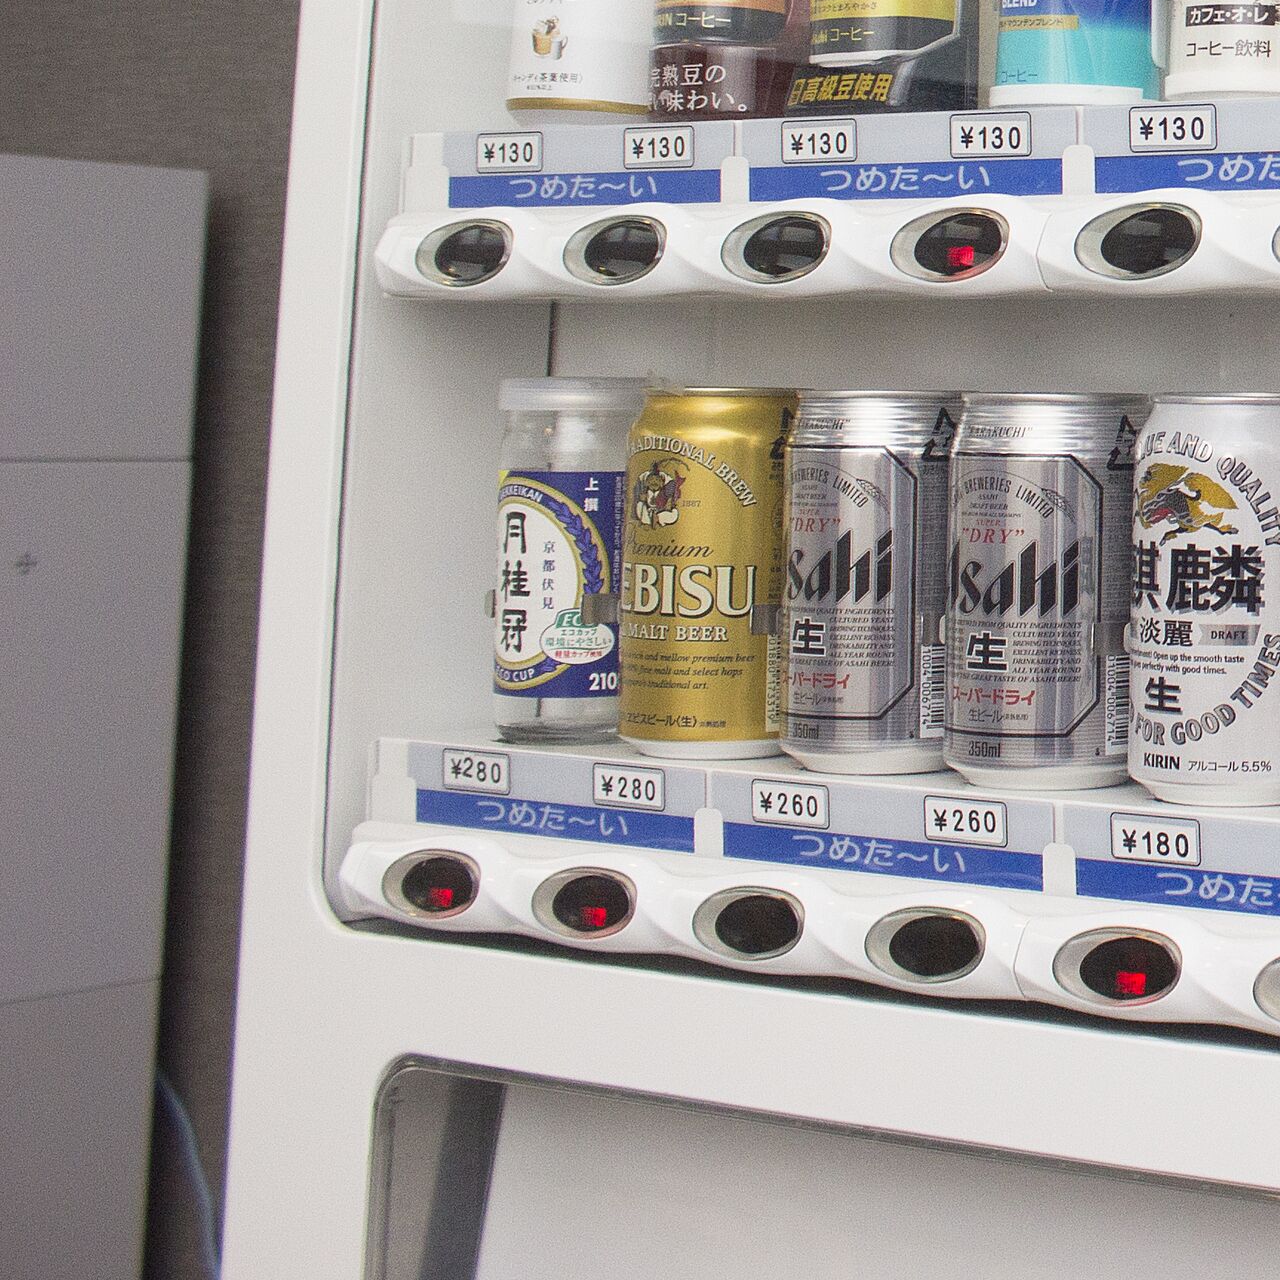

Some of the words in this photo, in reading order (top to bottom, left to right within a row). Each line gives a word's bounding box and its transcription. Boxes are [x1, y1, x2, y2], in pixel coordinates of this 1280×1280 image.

[676, 13, 731, 29] コーヒー
[1189, 7, 1269, 26] カフェ・オ・レ
[830, 26, 875, 42] コーヒー
[1186, 40, 1272, 59] コーヒー飲料
[959, 126, 1022, 150] ¥130
[1139, 115, 1206, 141] ¥130
[484, 144, 535, 163] ¥130
[631, 136, 687, 158] ¥130
[790, 132, 849, 155] ¥130
[1166, 431, 1213, 463] AND
[714, 462, 757, 508] BREW
[833, 475, 869, 508] LIMITED
[1015, 484, 1055, 519] LIMITED
[542, 540, 556, 610] 京都伏見
[675, 625, 729, 643] BEER
[792, 616, 826, 657] 生
[1140, 617, 1193, 647] 淡麗
[1211, 630, 1246, 640] DRAFT
[967, 631, 1009, 672] 生
[589, 672, 618, 691] 210
[953, 686, 1035, 706] スーパードライ
[1145, 676, 1183, 716] 生
[1135, 712, 1166, 746] FOR
[1171, 703, 1236, 746] GOOD
[968, 740, 1001, 758] 350ml
[451, 758, 502, 783] ¥280
[1143, 752, 1181, 771] KIRIN
[1188, 760, 1239, 772] アルコール
[1241, 760, 1272, 773] 5.5%
[600, 774, 656, 801] ¥280
[760, 791, 819, 818] ¥260
[933, 808, 997, 834] ¥260
[1122, 829, 1190, 857] ¥180
